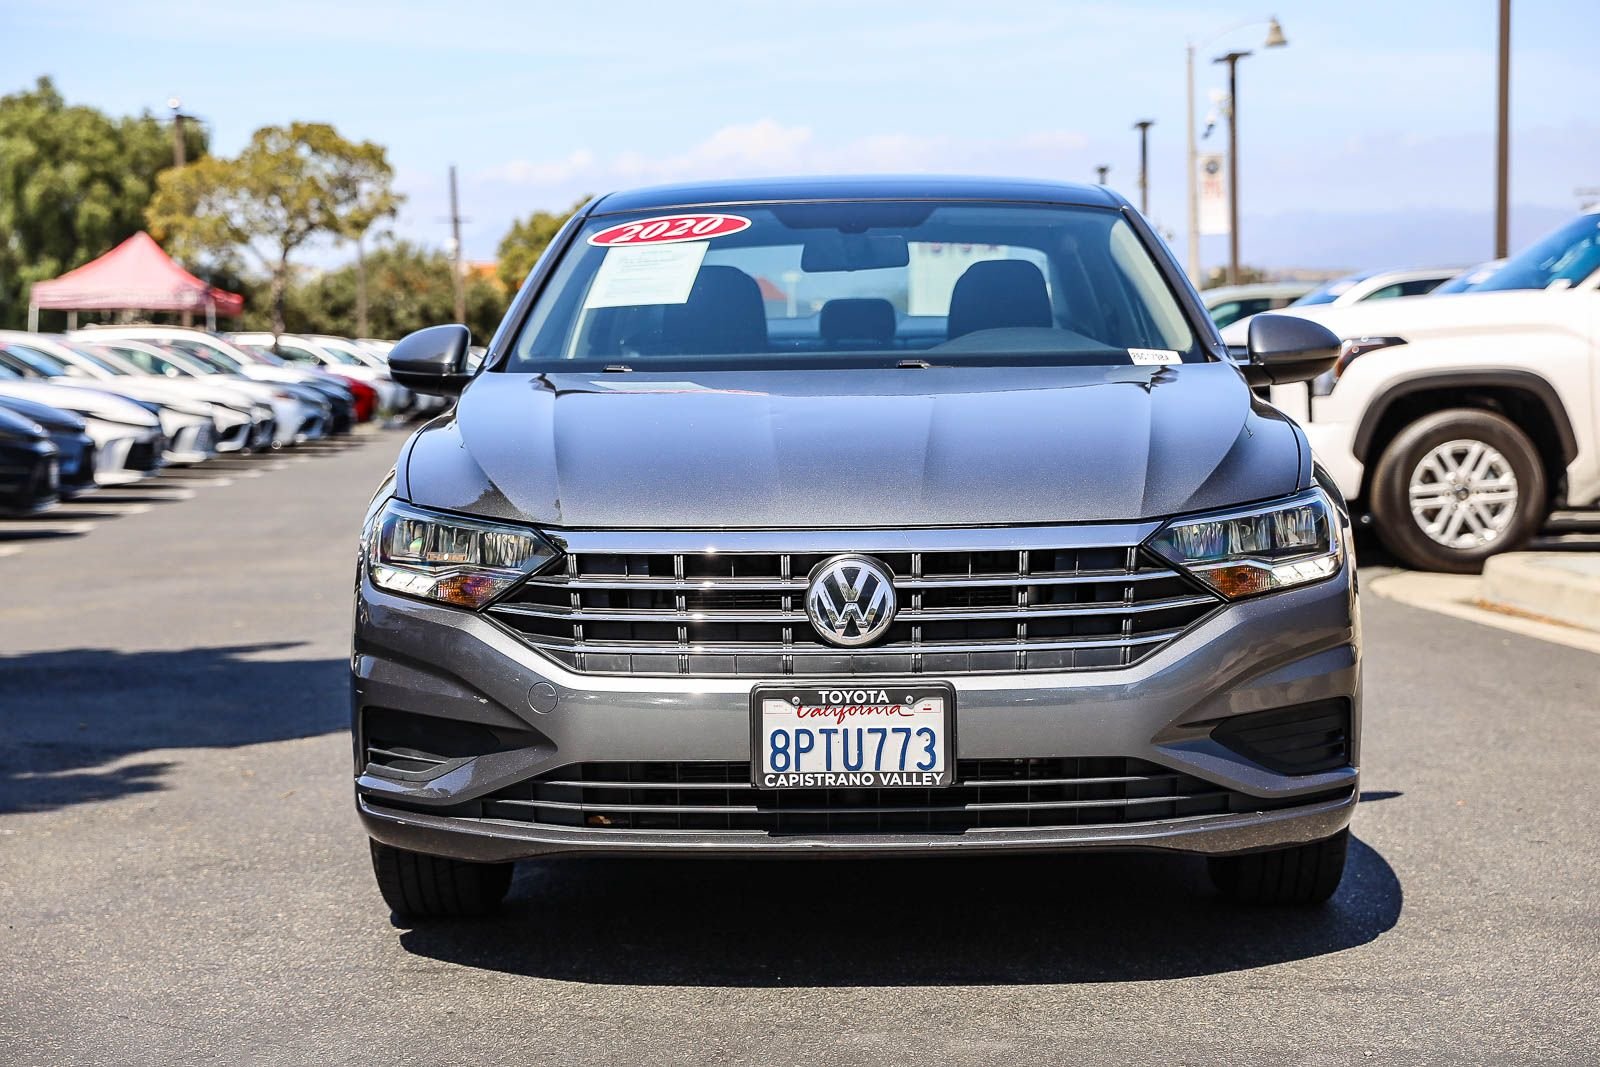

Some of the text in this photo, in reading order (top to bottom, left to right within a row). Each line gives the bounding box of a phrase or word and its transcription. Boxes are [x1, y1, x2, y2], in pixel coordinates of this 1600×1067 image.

[609, 217, 724, 244] 2020
[818, 690, 890, 704] TOYOTA
[769, 726, 937, 773] 8PTU773
[764, 772, 944, 788] CAPISTRANO VALLEY
